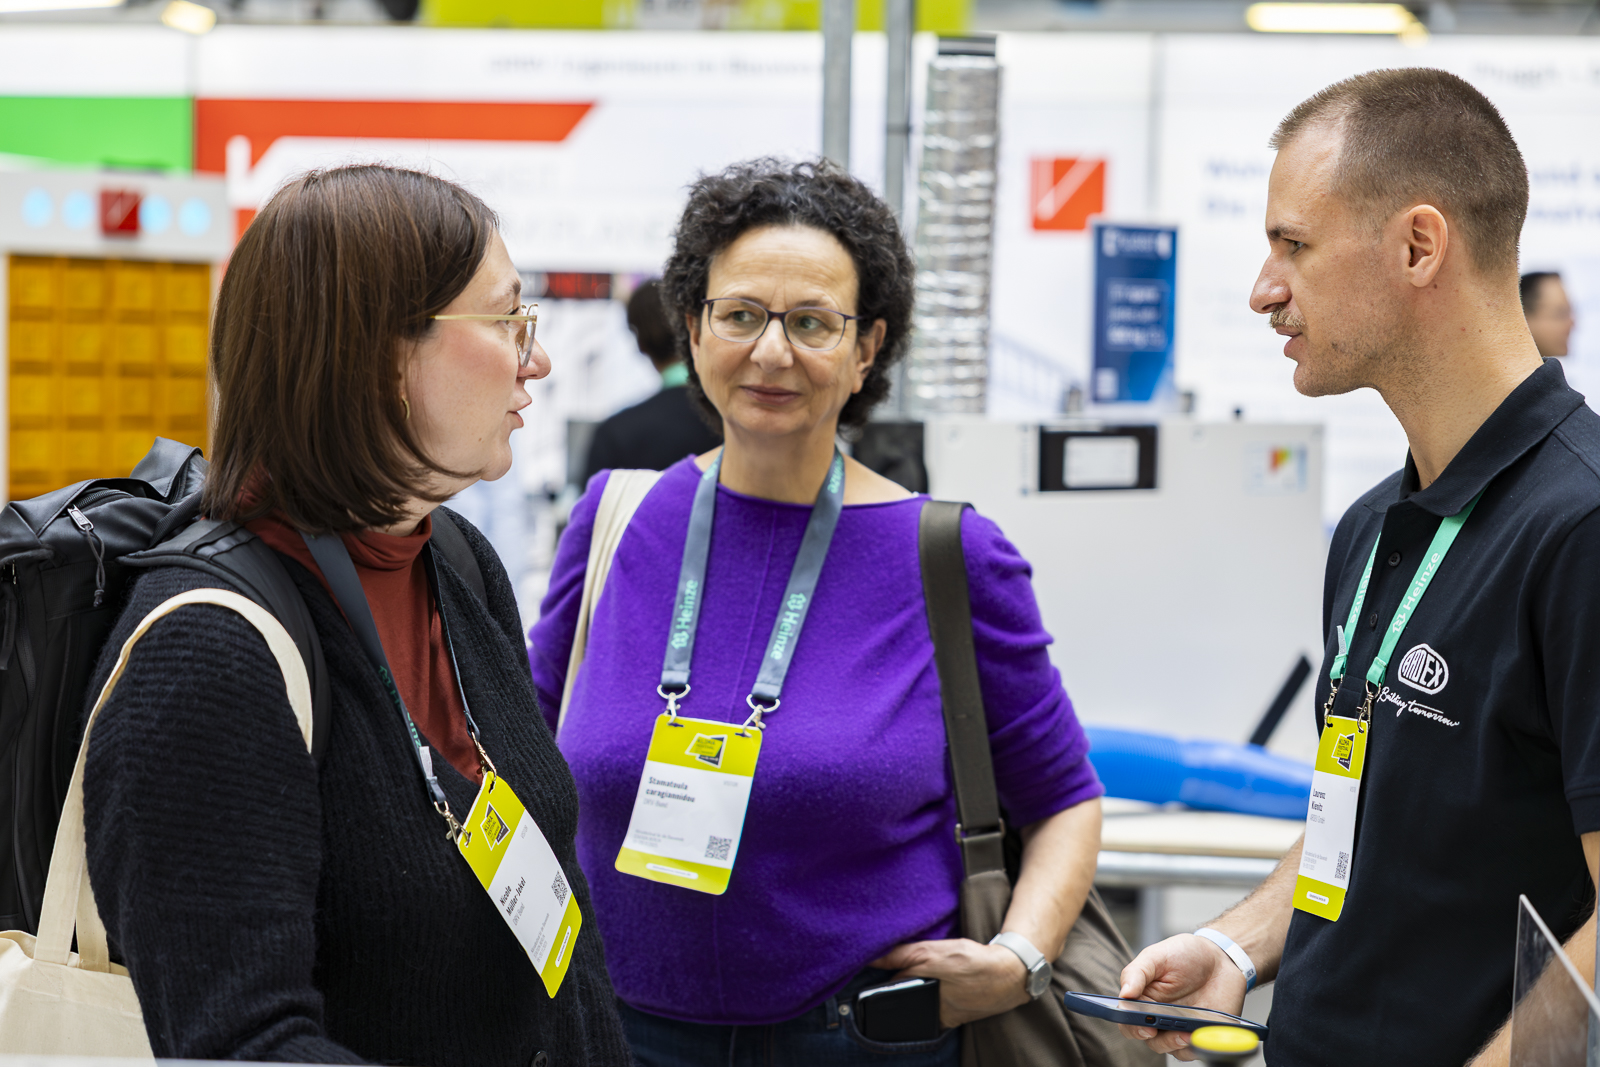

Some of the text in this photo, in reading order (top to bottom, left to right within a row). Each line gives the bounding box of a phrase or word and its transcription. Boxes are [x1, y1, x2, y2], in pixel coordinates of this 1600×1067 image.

[1402, 552, 1440, 611] Heinze
[675, 579, 699, 630] Heinze
[770, 610, 801, 660] Heinze
[1407, 700, 1460, 727] tomorrow
[648, 776, 688, 791] Stamatoula
[484, 815, 494, 832] KLIMA
[499, 885, 512, 907] Nicole
